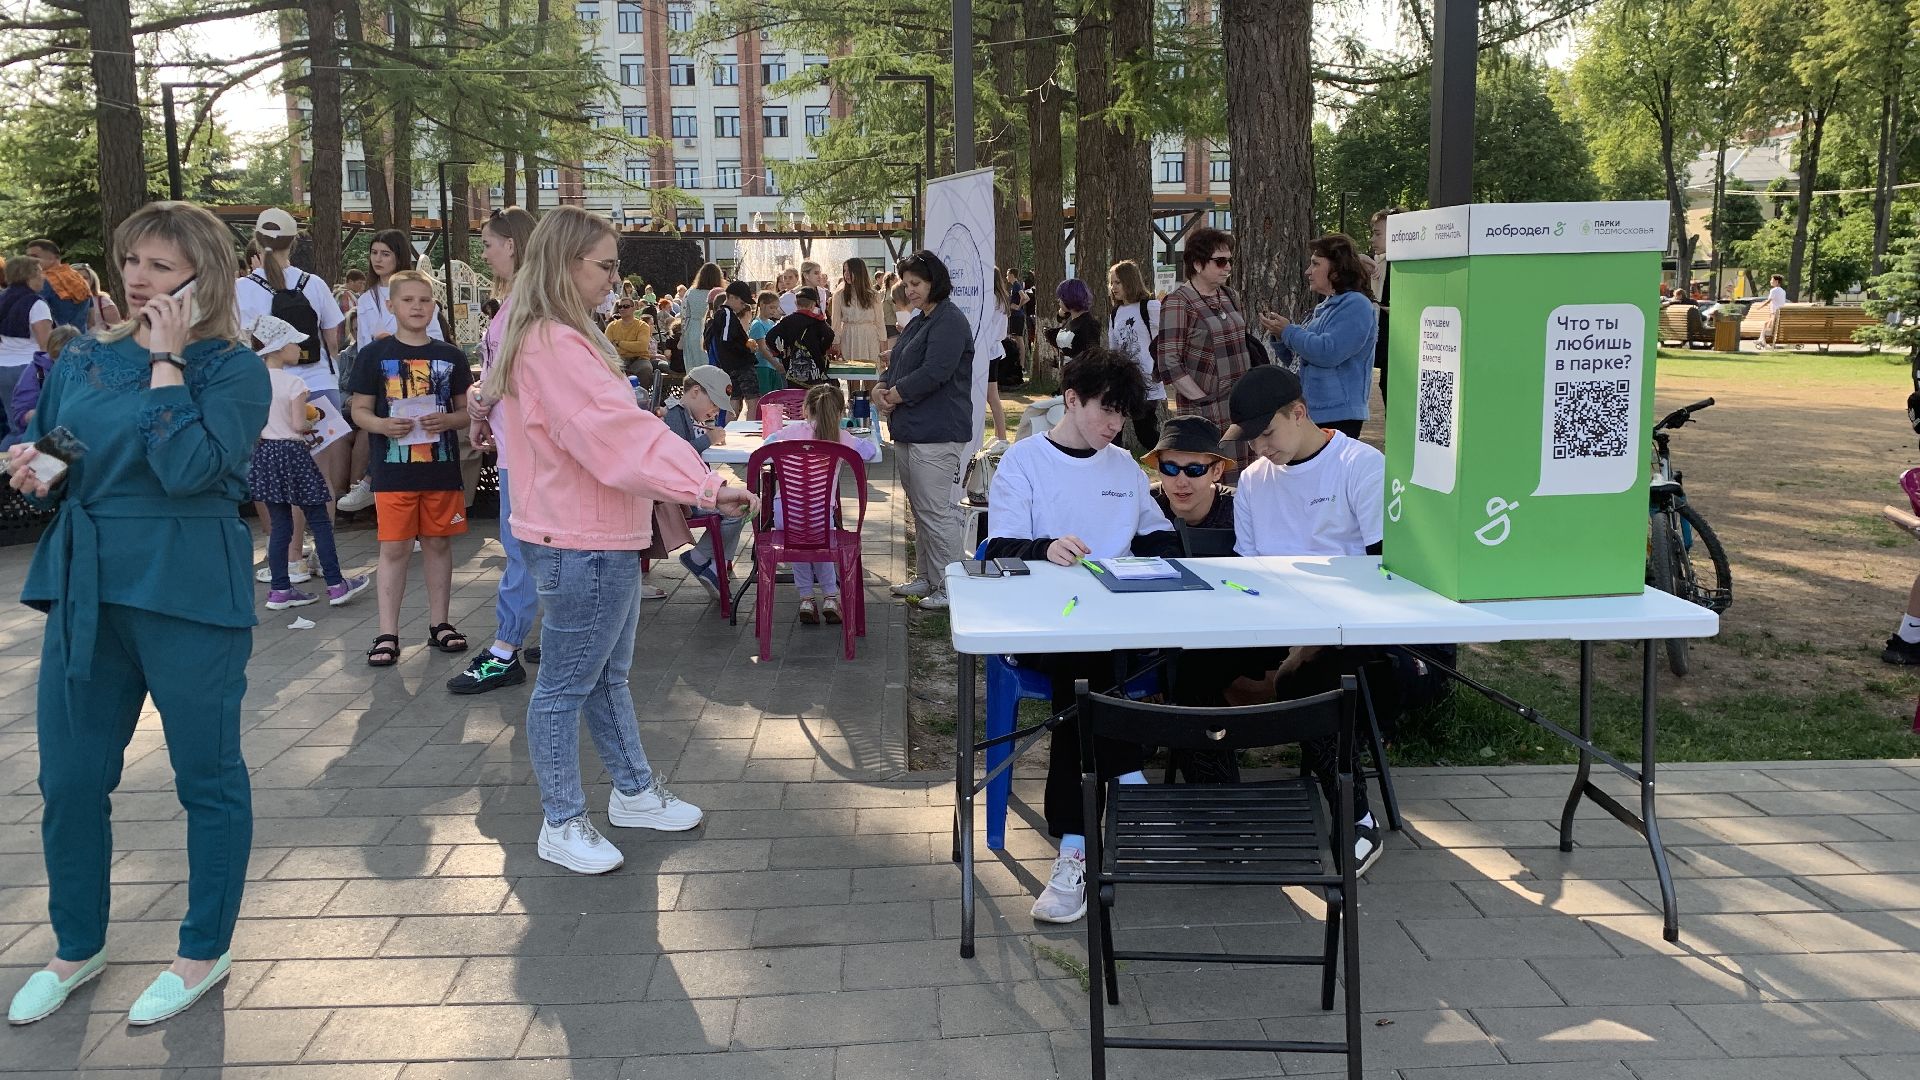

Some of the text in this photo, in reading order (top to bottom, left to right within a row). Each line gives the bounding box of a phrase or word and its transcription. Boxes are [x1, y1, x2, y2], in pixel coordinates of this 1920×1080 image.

[1486, 223, 1550, 237] добродел
[1594, 220, 1621, 228] ПАРКИ
[1557, 315, 1619, 331] Что ты
[1555, 333, 1632, 351] любишь
[1555, 354, 1632, 374] в парке?
